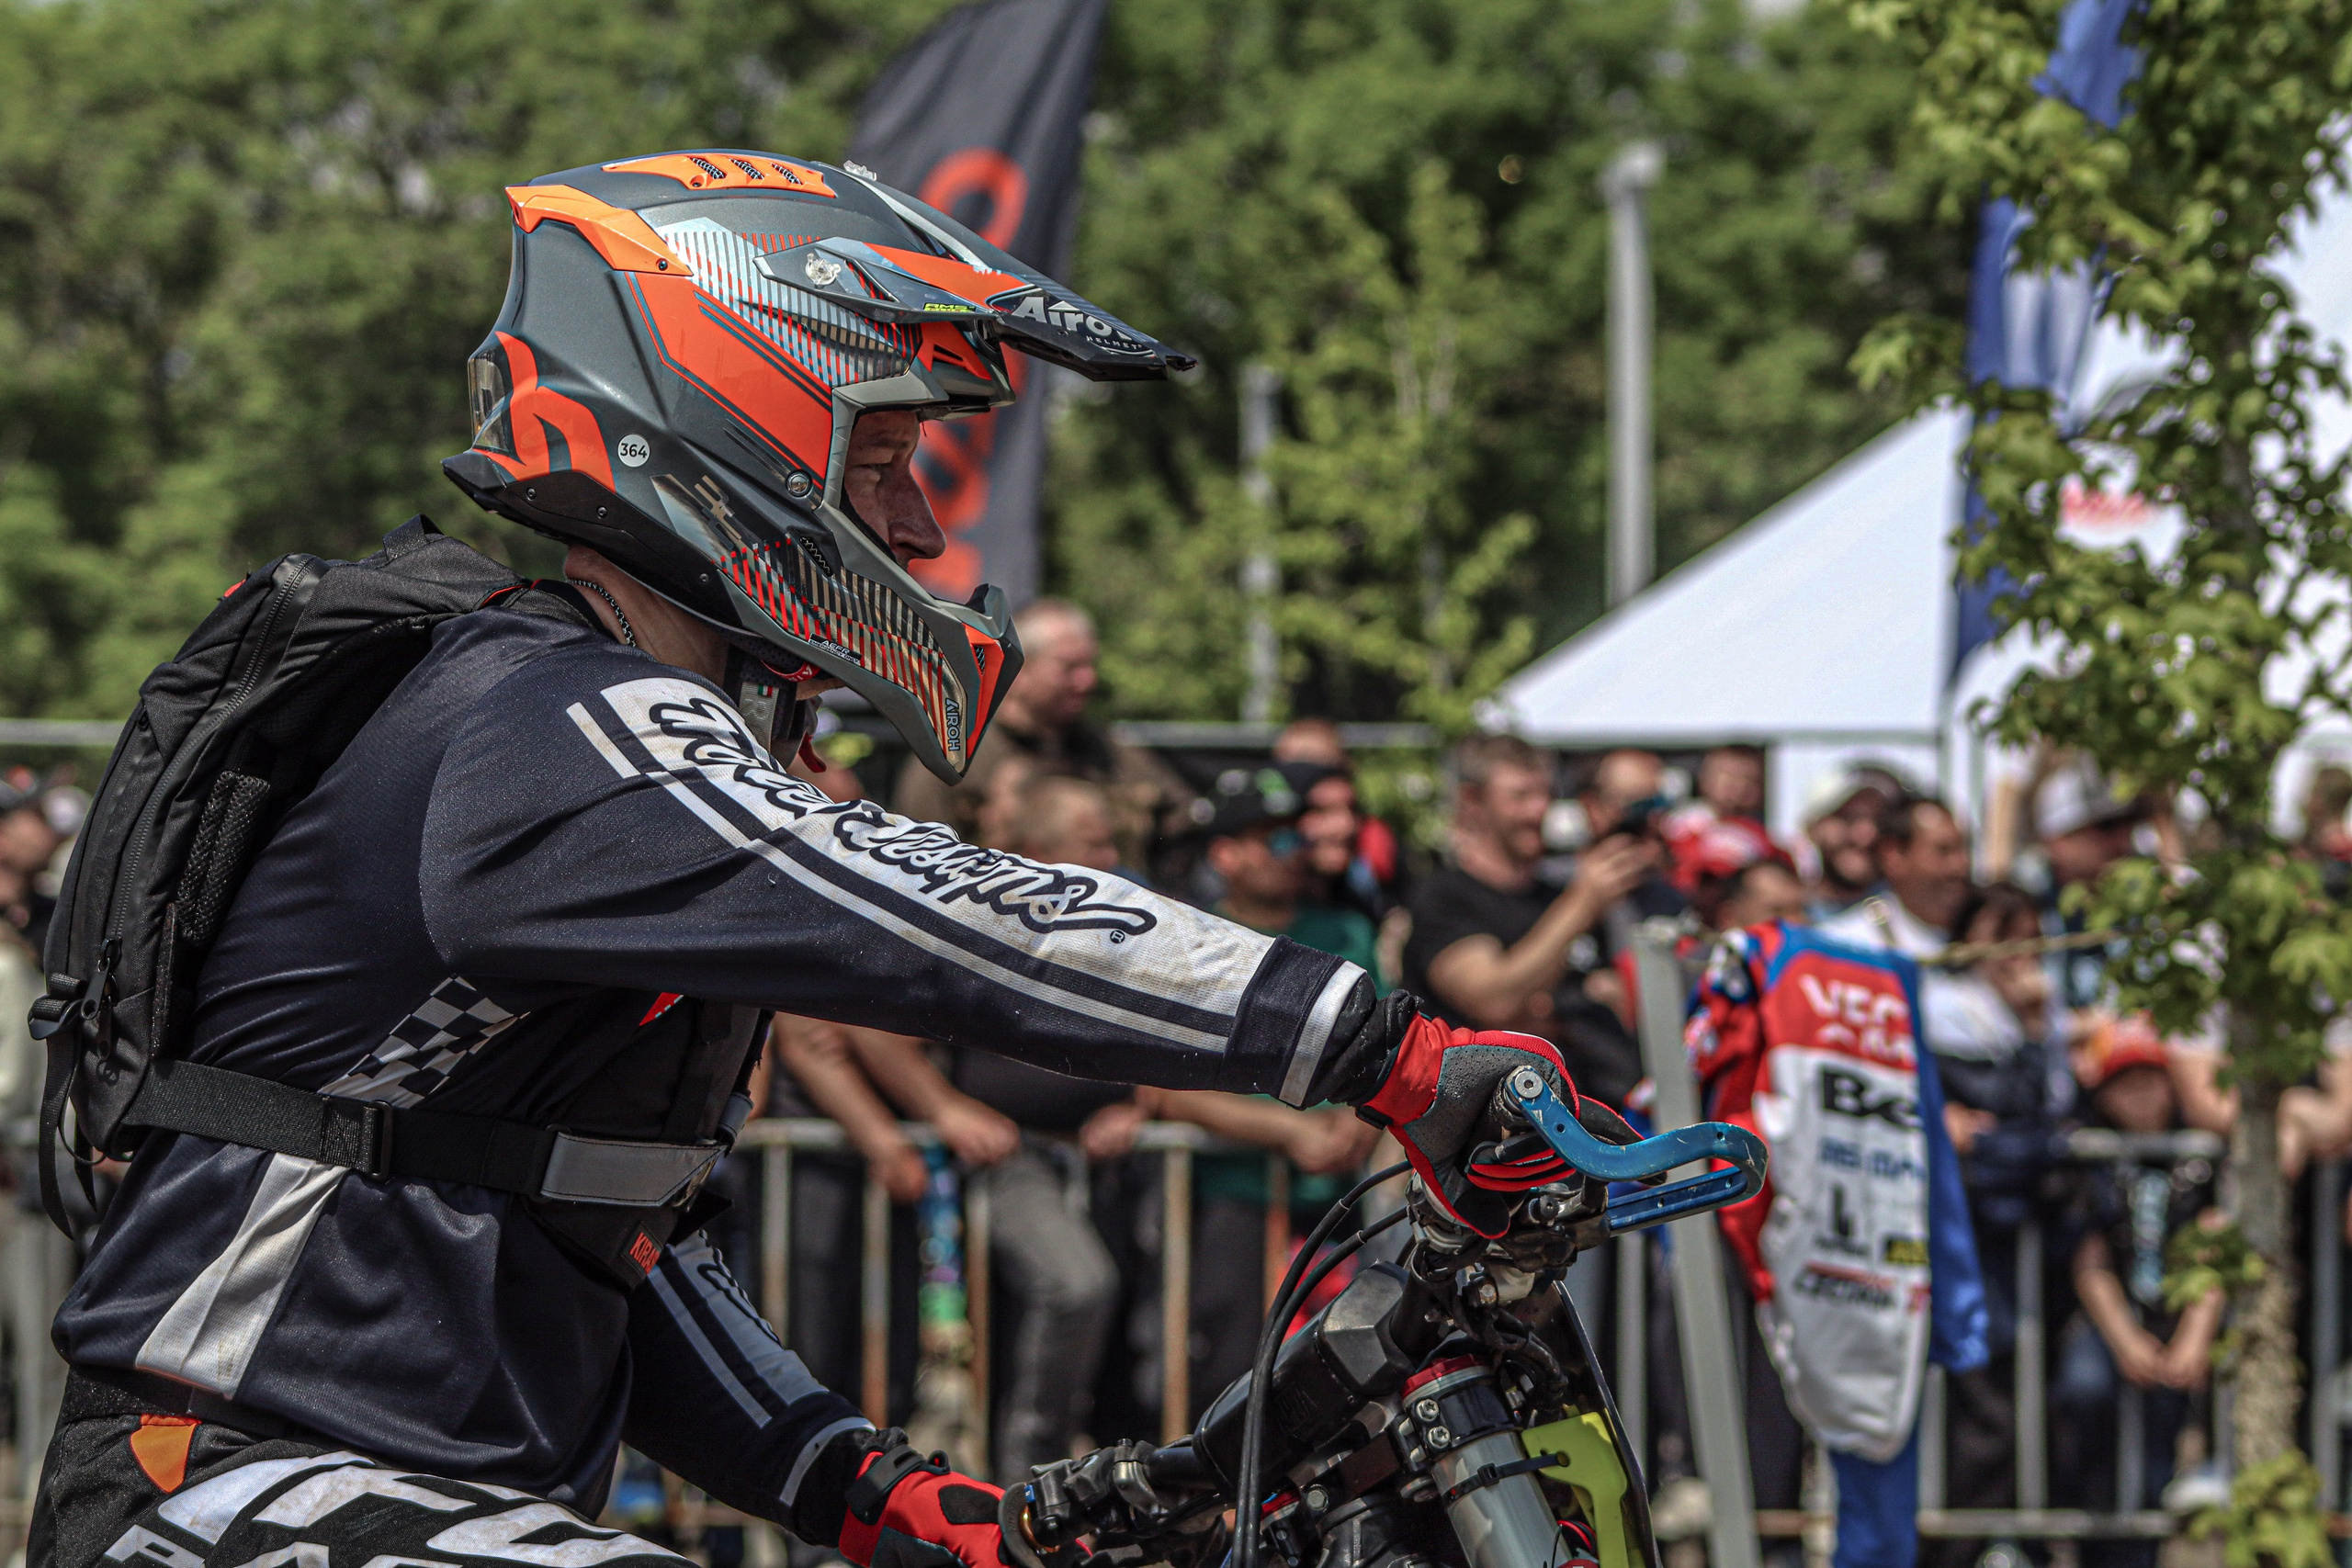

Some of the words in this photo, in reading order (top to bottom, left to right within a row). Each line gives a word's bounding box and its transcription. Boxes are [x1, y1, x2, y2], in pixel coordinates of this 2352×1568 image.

[1086, 335, 1138, 350] HELMET
[619, 442, 648, 458] 364
[945, 697, 961, 751] AIROH
